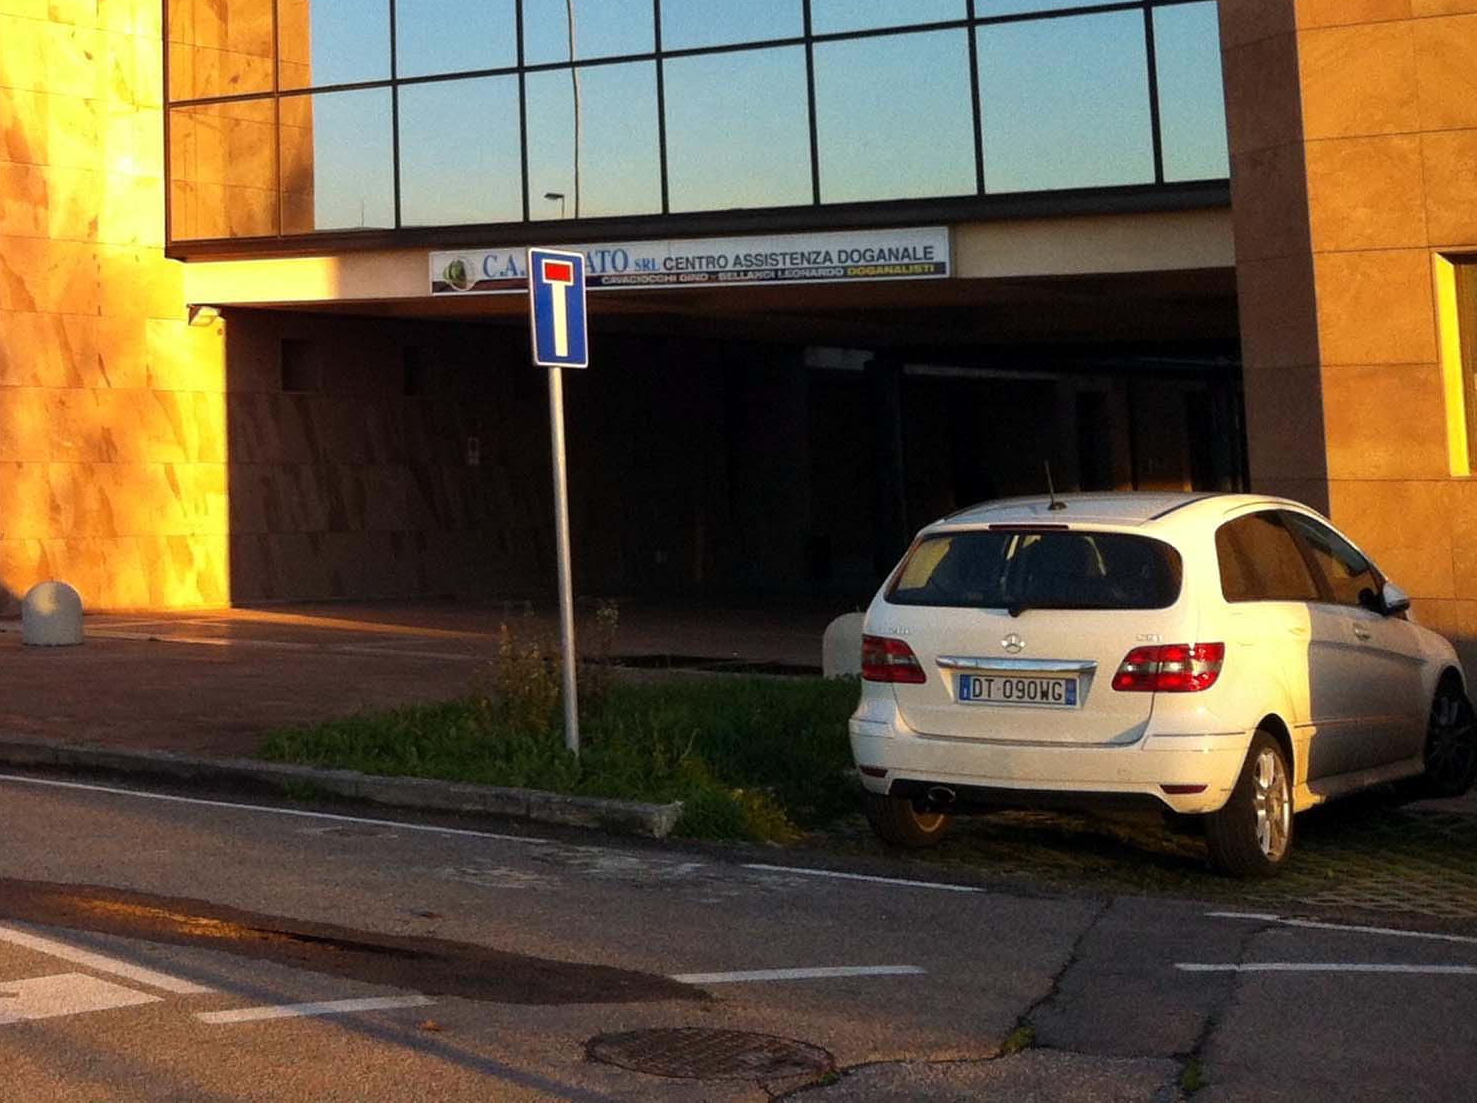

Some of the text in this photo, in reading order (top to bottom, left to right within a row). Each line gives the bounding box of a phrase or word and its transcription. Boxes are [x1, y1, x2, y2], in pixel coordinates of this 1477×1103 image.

[584, 248, 629, 274] ATO
[634, 258, 661, 272] SRL
[663, 255, 728, 271] CENTRO
[732, 250, 834, 269] ASSISTENZA
[837, 245, 935, 264] DOGANALE
[972, 677, 996, 699] DT
